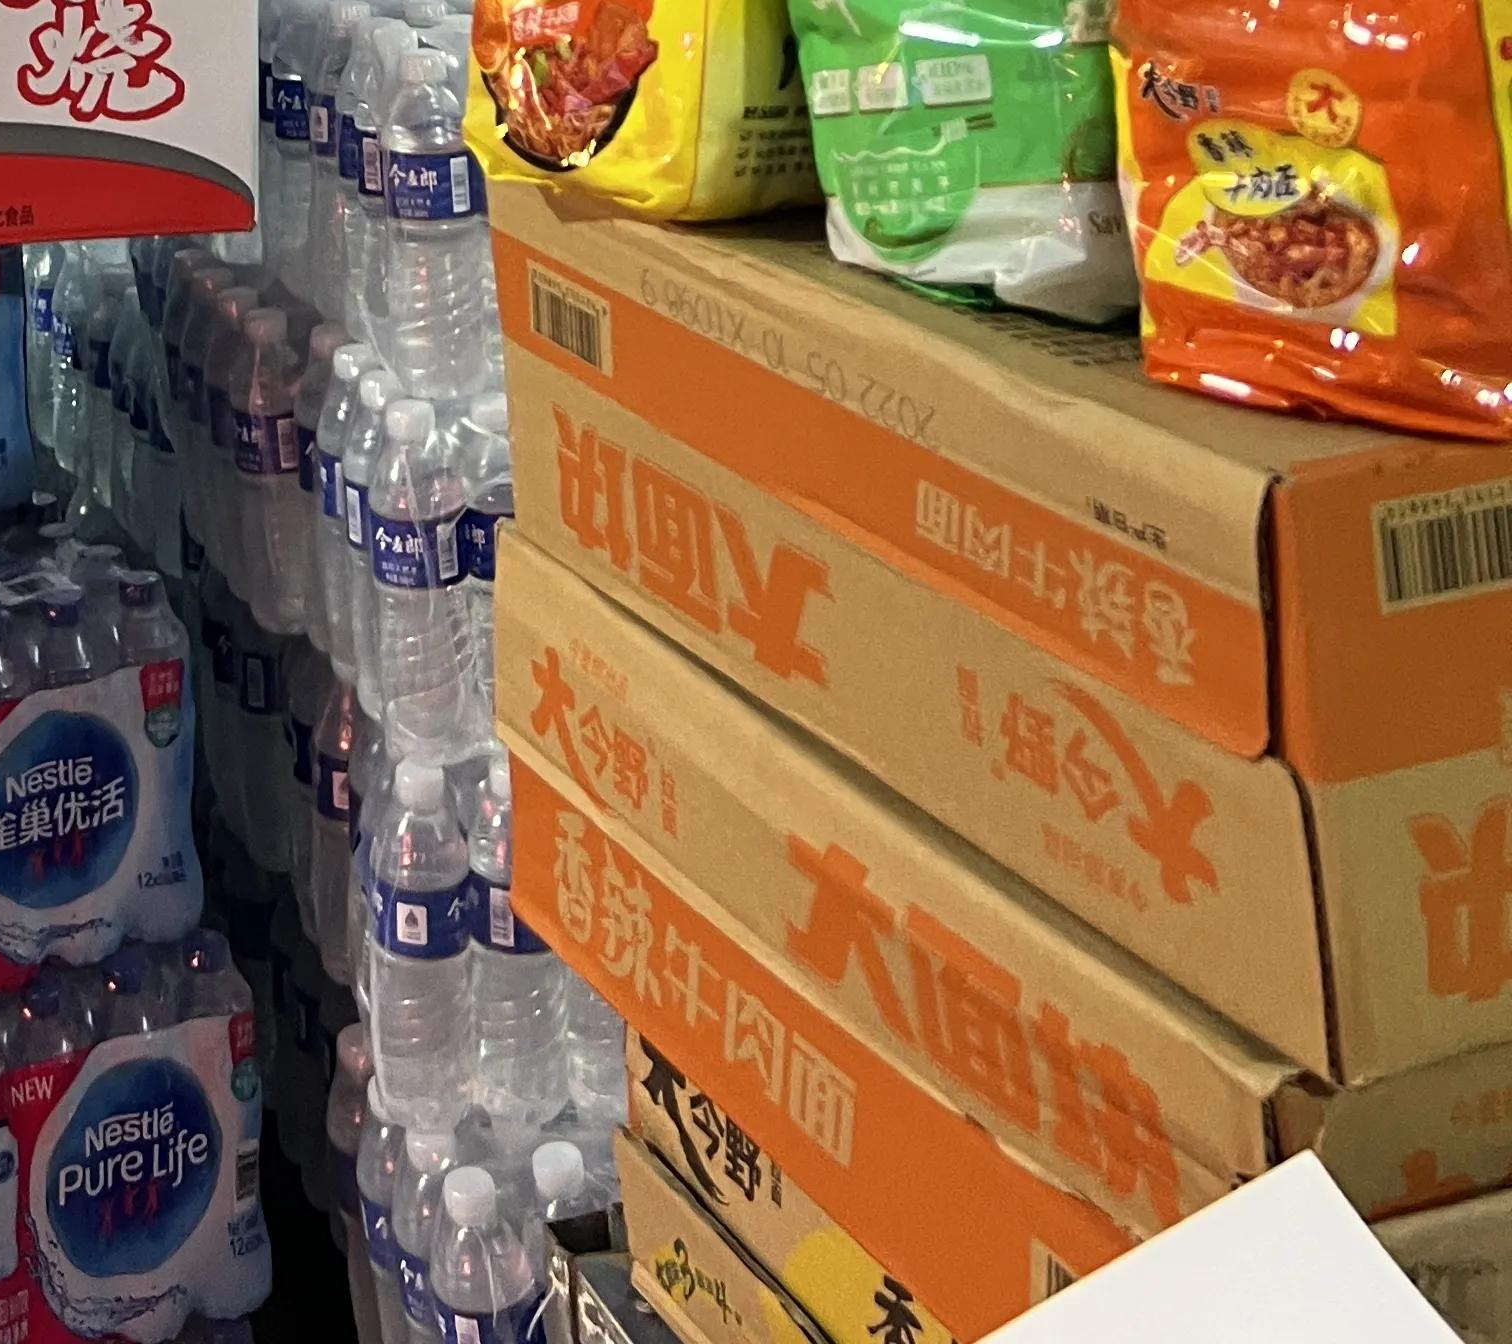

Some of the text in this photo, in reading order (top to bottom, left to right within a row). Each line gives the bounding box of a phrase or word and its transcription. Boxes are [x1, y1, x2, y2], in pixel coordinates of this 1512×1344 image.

[389, 166, 438, 192] 今麦郎
[376, 527, 426, 555] 今麦郎
[552, 401, 835, 690] 大面块
[916, 478, 1198, 687] 香辣牛肉面
[6, 756, 93, 803] Nestlé
[530, 646, 649, 819] 大今野
[1000, 676, 1220, 905] 大今野
[554, 810, 856, 1168] 香辣牛肉面
[787, 833, 1181, 1224] 大面块
[11, 1074, 55, 1106] NEW
[58, 1128, 209, 1206] Pure Life
[85, 1101, 175, 1158] Nestlé
[638, 1034, 761, 1205] 大今野
